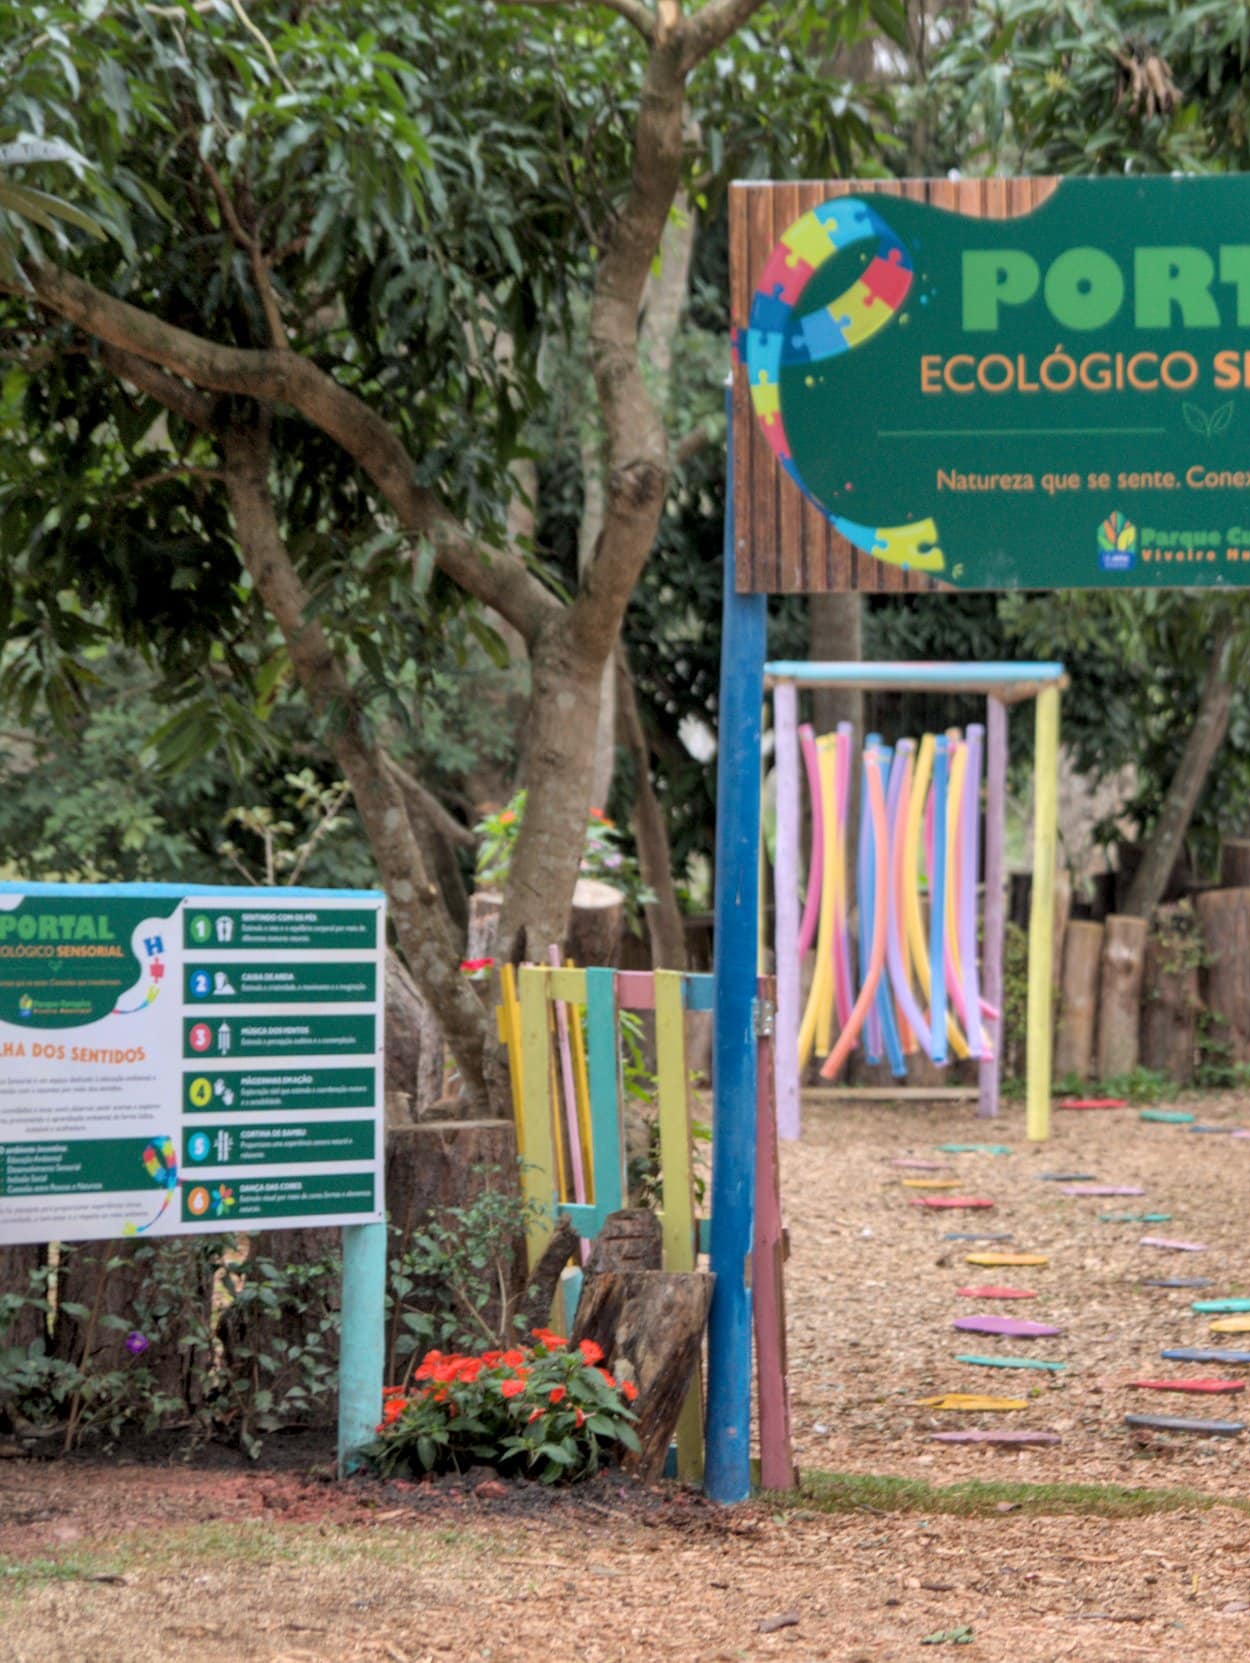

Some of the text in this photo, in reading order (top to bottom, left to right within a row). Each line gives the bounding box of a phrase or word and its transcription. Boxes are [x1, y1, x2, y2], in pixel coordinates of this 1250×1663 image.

[920, 343, 1199, 393] ECOLÓGICO
[936, 468, 1035, 491] Natureza
[1040, 472, 1081, 495] que
[1087, 471, 1110, 490] se
[1117, 469, 1181, 489] sente.
[1140, 526, 1221, 549] Parque
[1141, 547, 1216, 562] Viveiro
[0, 914, 115, 940] PORTAL
[196, 921, 205, 937] 1
[0, 944, 124, 958] OLÓGICO SENSORIAL
[195, 975, 206, 992] 2
[196, 1030, 206, 1045] 3
[0, 1042, 146, 1064] HA DOS SENTIDOS
[196, 1084, 206, 1101] 4
[195, 1139, 204, 1154] 5
[193, 1191, 204, 1208] 6
